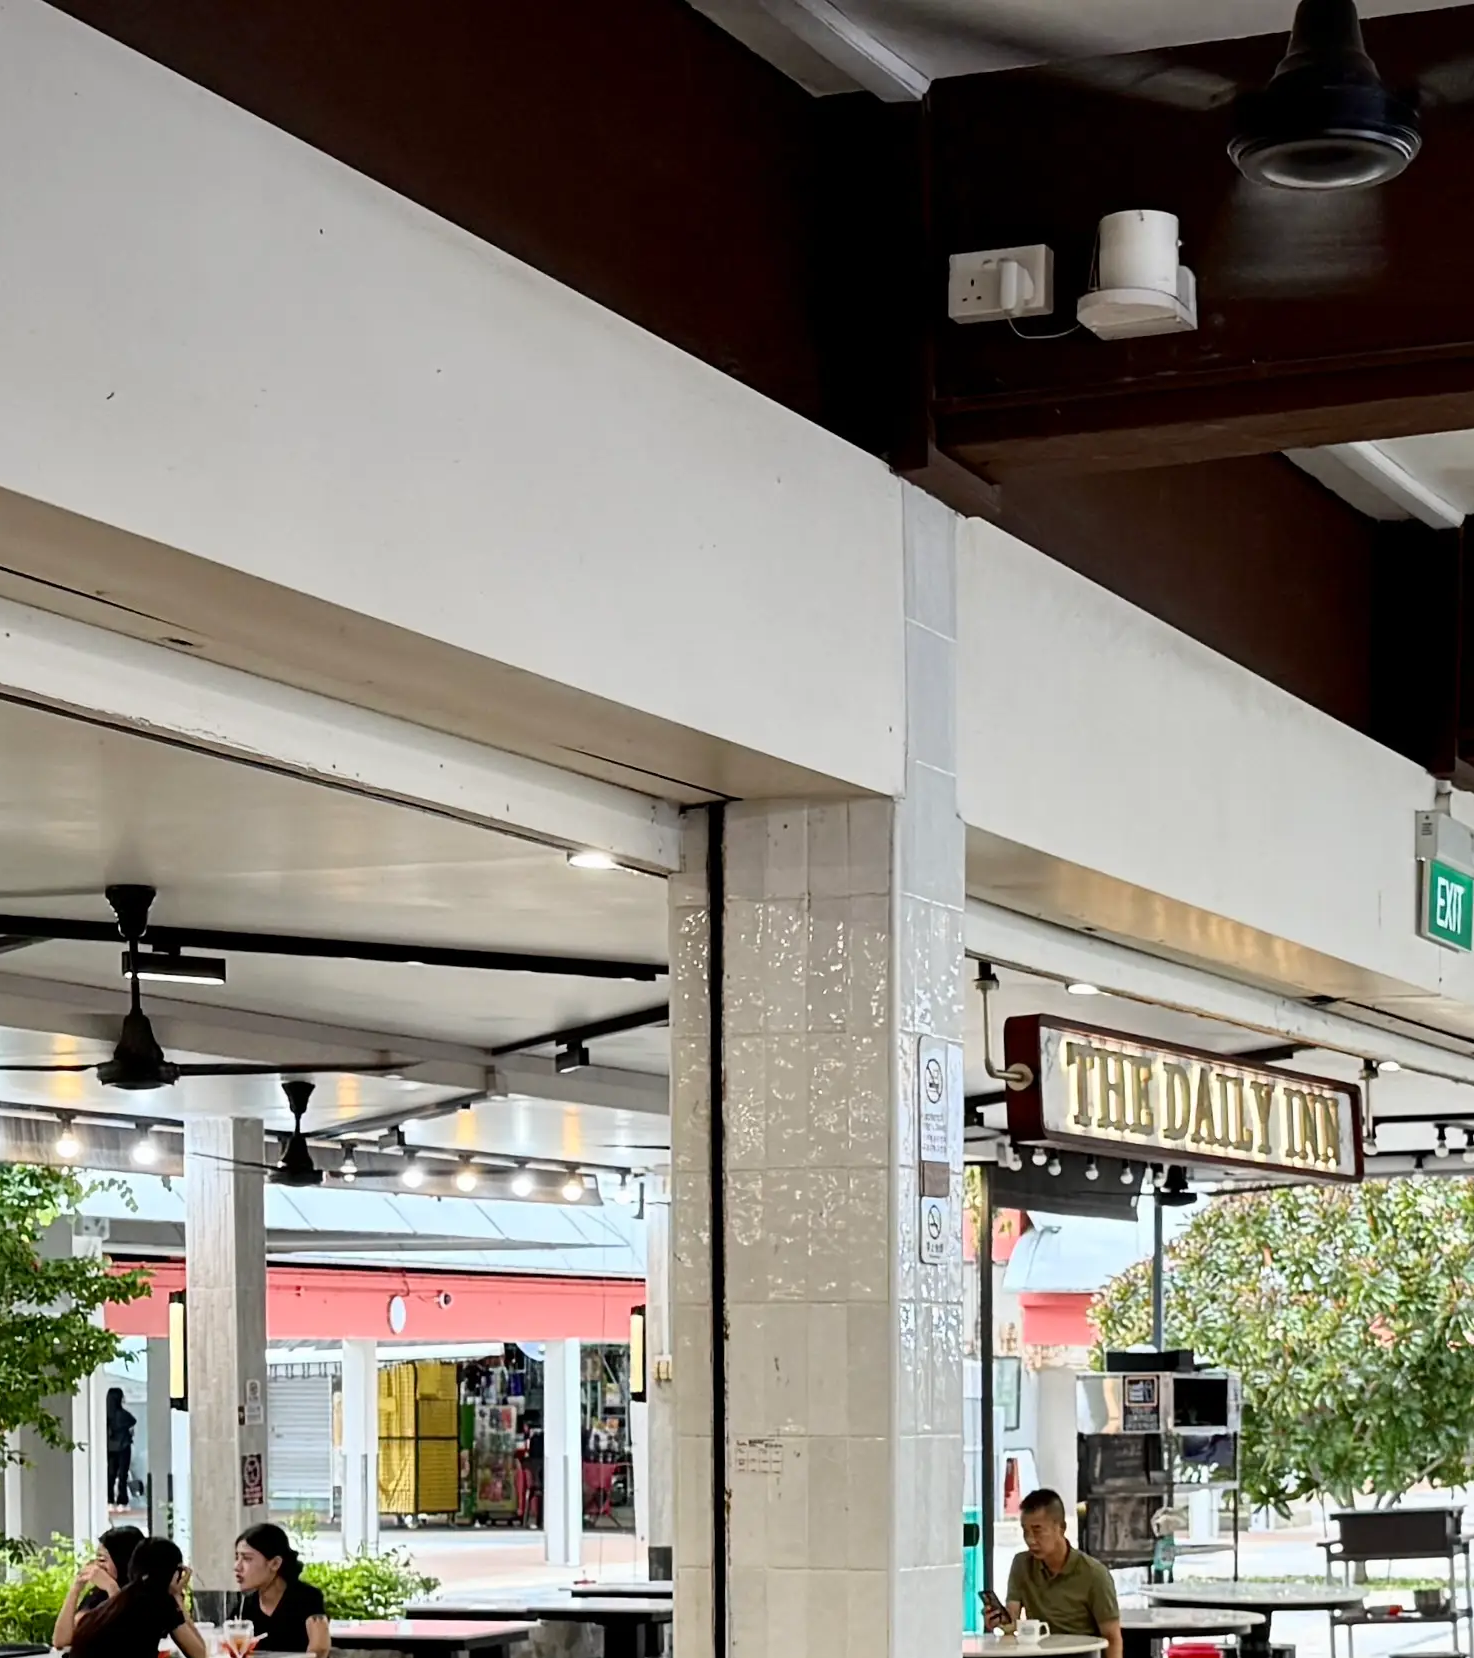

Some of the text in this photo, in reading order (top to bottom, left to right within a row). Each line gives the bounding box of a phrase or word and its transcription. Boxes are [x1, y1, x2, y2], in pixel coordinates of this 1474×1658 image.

[1436, 876, 1466, 935] EXIT
[1065, 1039, 1341, 1170] THE DAILY INN
